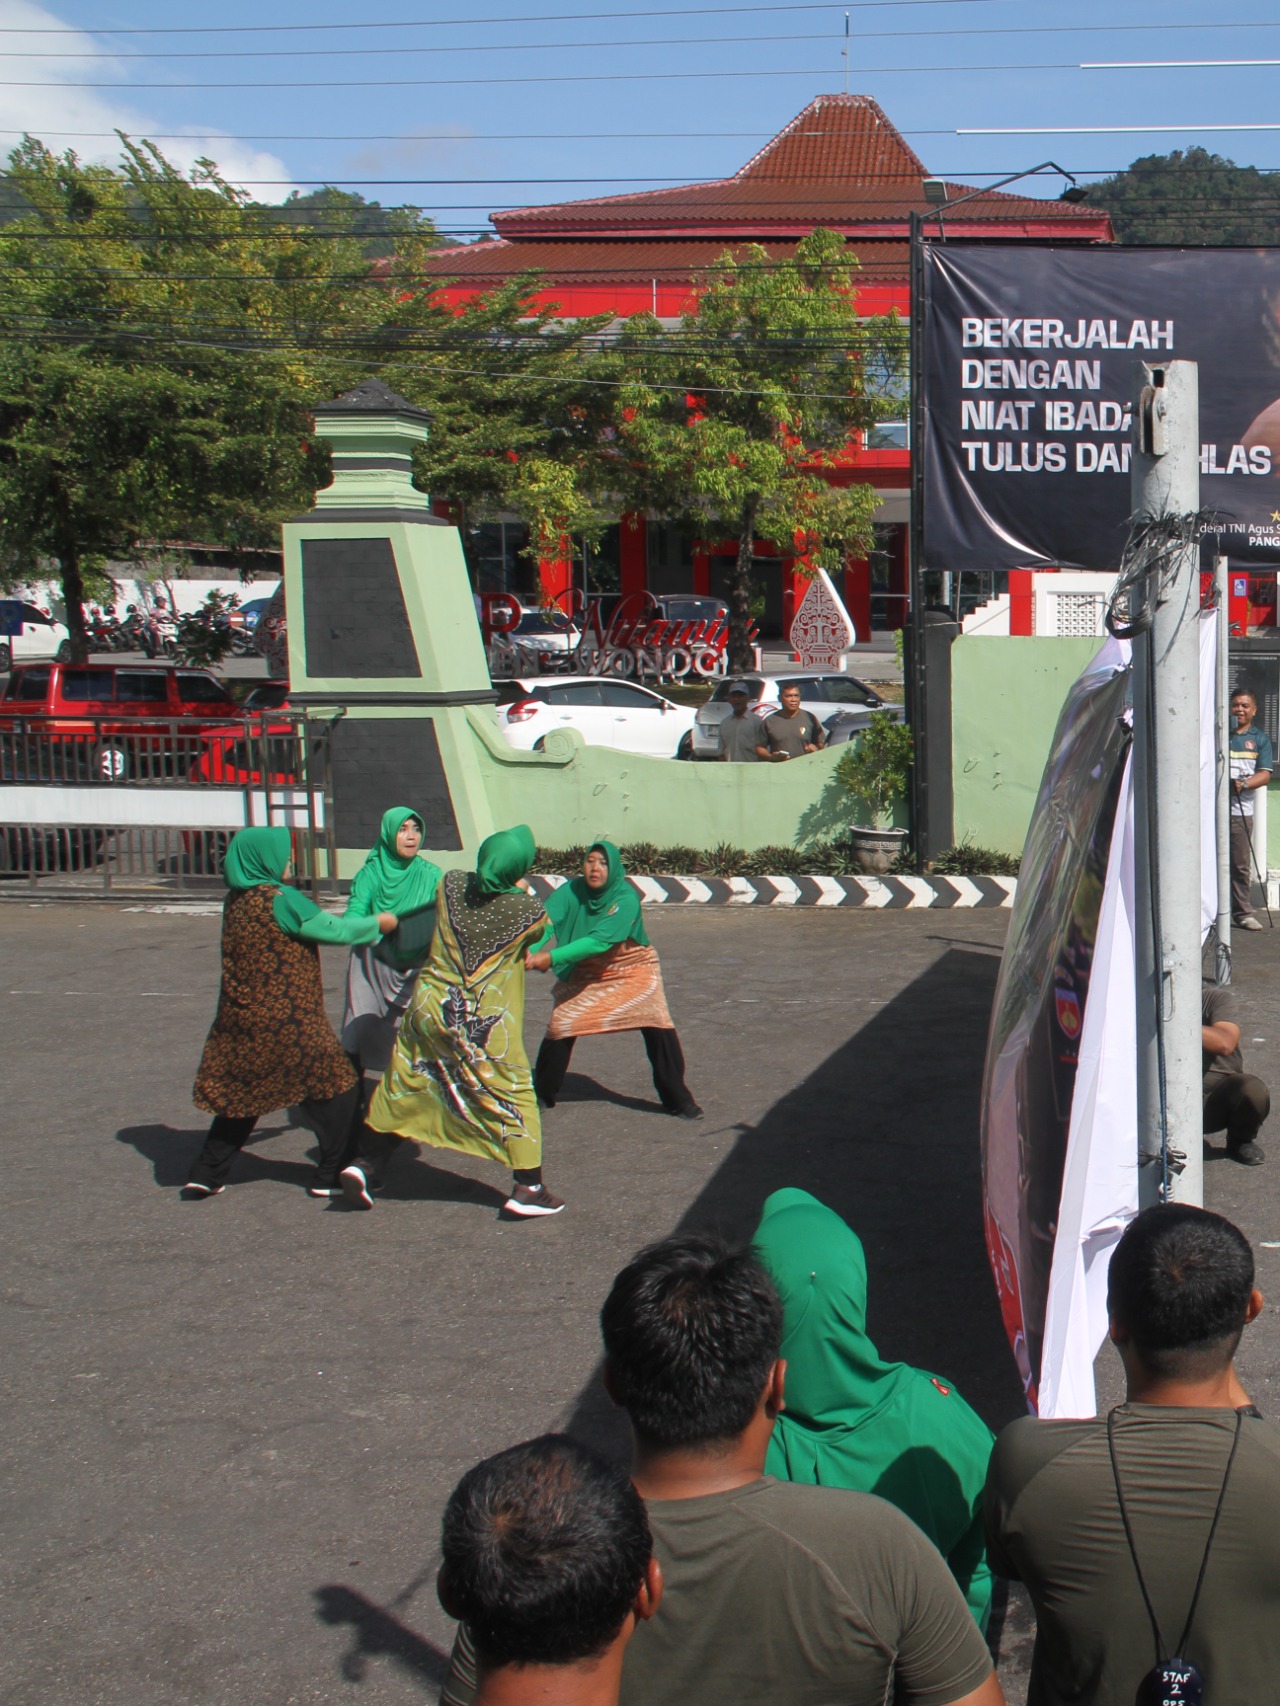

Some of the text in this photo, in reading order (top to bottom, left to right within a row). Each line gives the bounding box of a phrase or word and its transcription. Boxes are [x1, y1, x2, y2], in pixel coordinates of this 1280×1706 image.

[962, 318, 1174, 350] BEKERJALAH
[962, 359, 1100, 390] DENGAN
[961, 400, 1132, 432] NIAT IBAD
[961, 442, 1067, 473] TULUS
[1199, 524, 1227, 534] deral
[1228, 524, 1246, 533] TNI
[1248, 523, 1274, 536] Agus
[577, 647, 764, 677] WONOGII
[1162, 1671, 1191, 1683] STAF
[1170, 1684, 1181, 1694] 2
